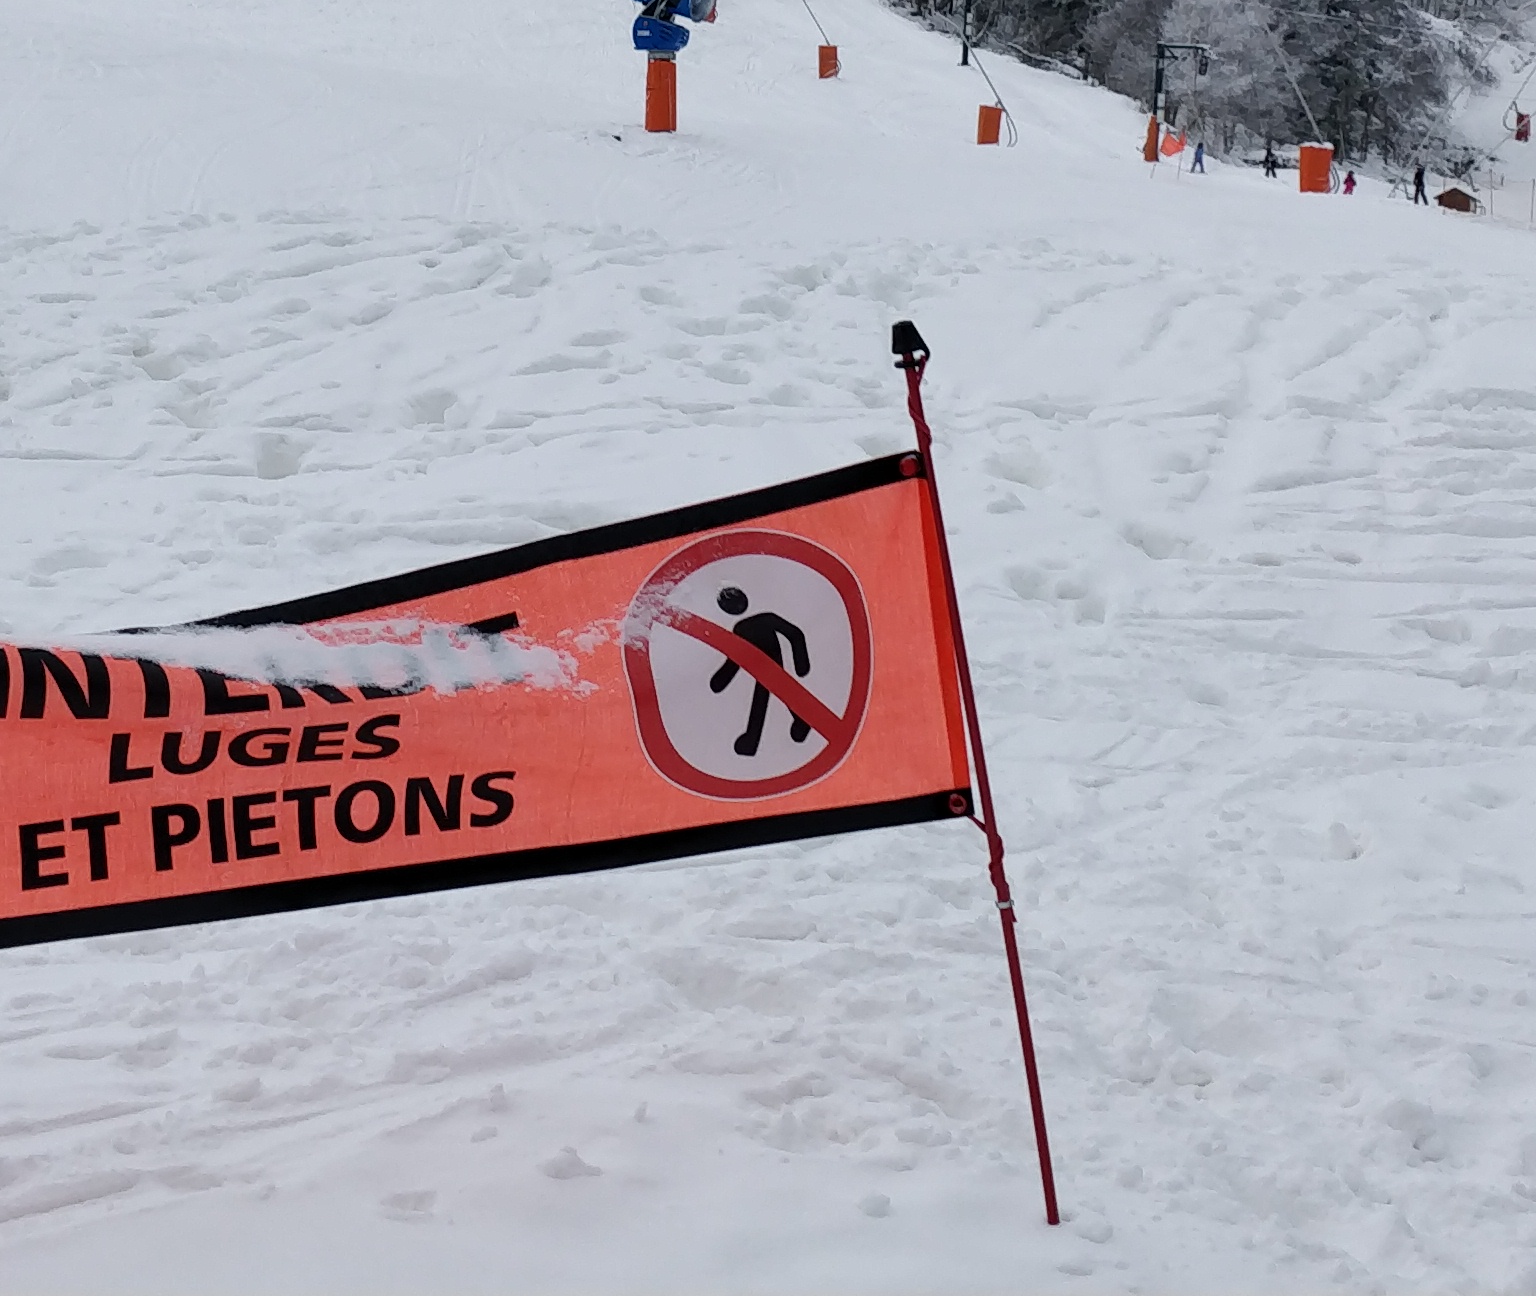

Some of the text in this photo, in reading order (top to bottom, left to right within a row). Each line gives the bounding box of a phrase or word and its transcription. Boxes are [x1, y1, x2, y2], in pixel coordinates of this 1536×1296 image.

[108, 714, 401, 784] LUGES
[19, 771, 517, 891] ET PIETONS
